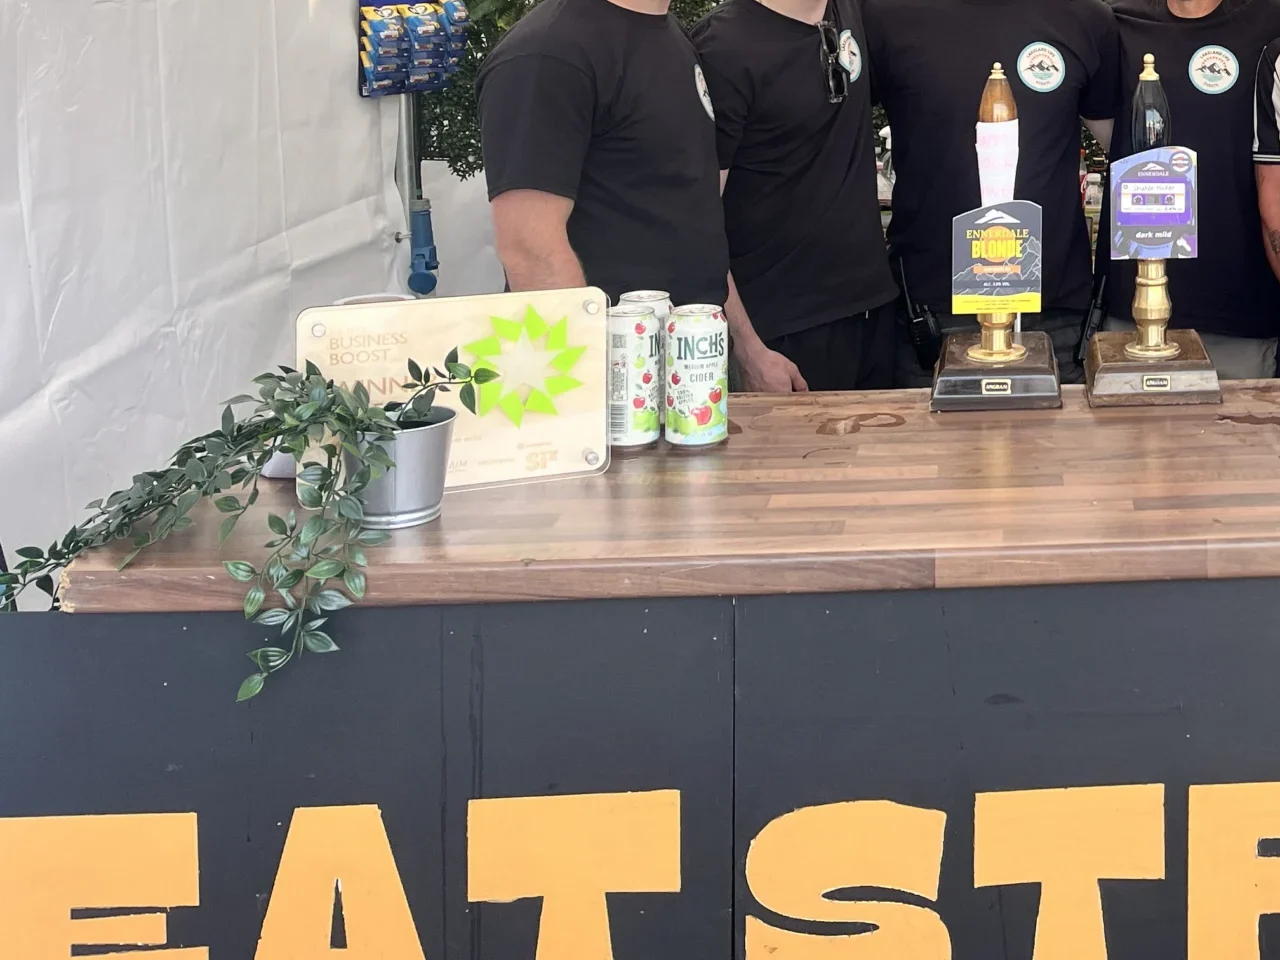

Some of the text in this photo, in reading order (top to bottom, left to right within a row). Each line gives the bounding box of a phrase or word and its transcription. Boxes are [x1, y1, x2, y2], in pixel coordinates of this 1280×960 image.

[966, 228, 1030, 239] ENNERDALE
[1135, 230, 1173, 239] dark mild
[971, 239, 1024, 259] BLONDE
[329, 331, 408, 351] BUSINESS
[329, 348, 391, 367] BOOST
[689, 371, 715, 383] CIDER
[0, 789, 682, 960] EAT
